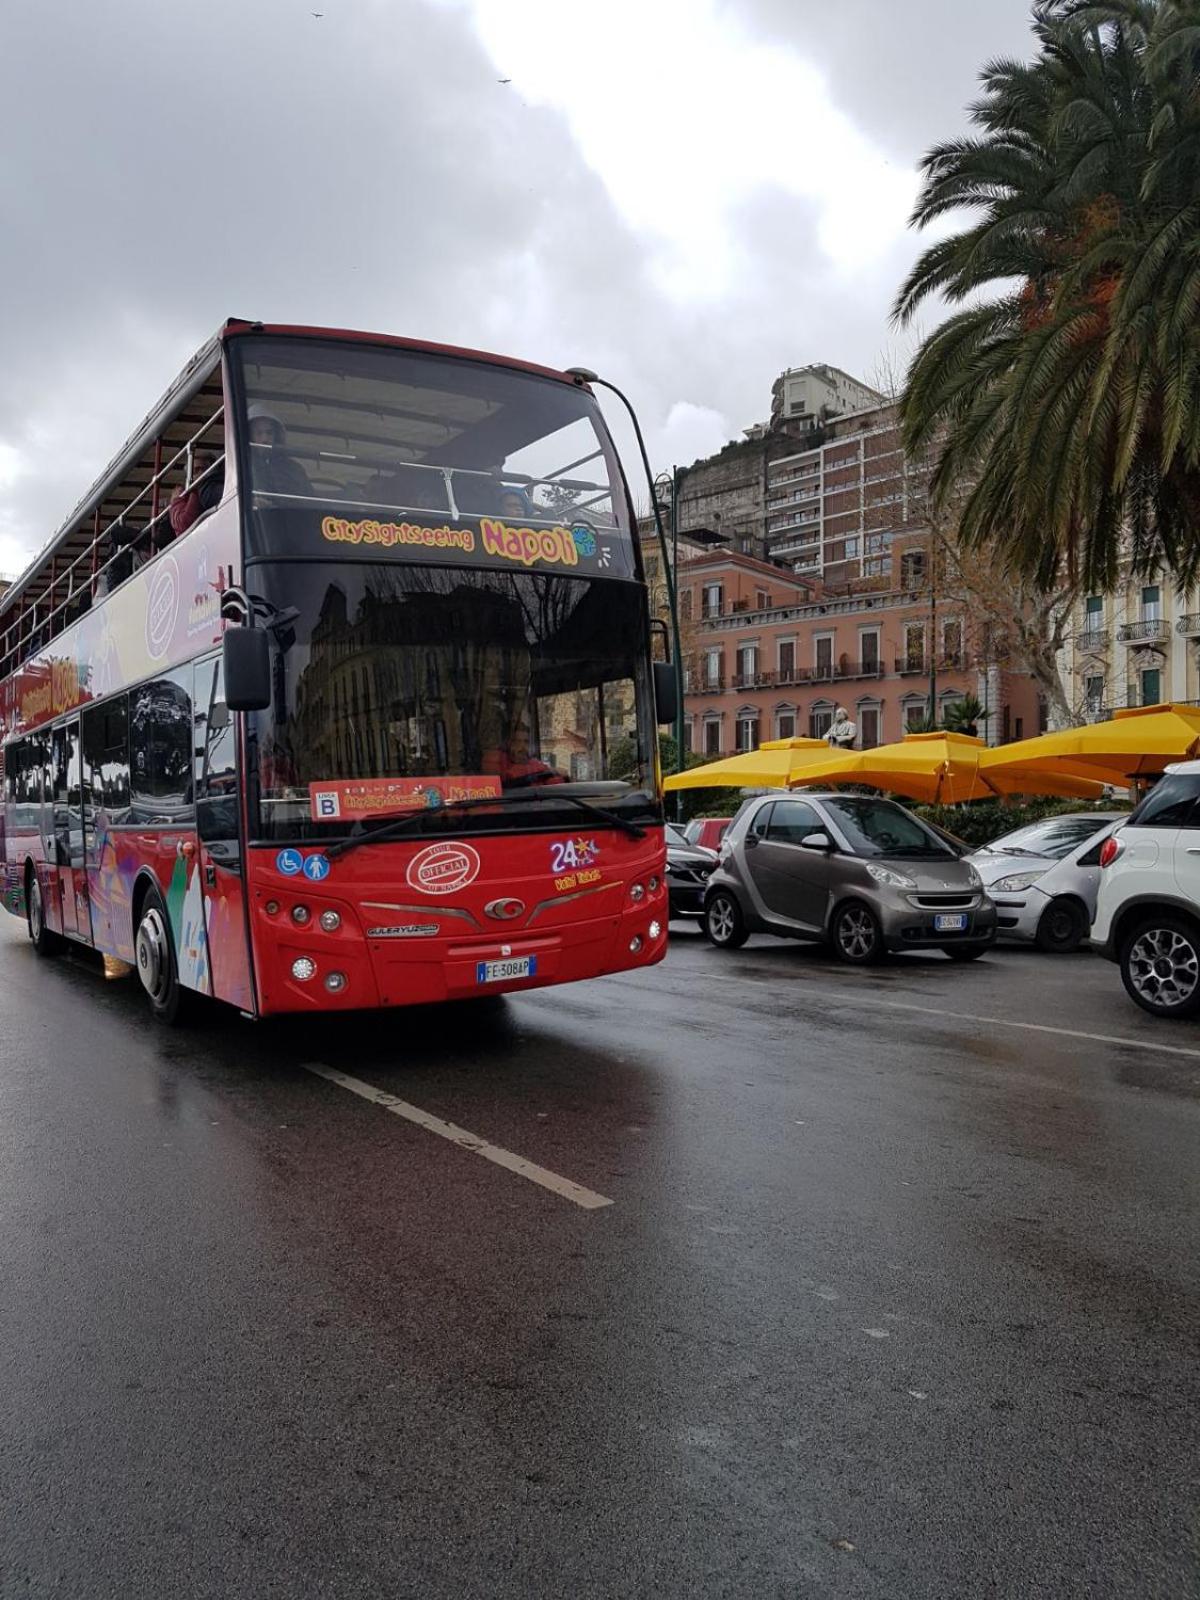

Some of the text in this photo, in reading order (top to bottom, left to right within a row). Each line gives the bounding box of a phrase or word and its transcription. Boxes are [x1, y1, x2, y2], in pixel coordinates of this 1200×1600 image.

[322, 515, 578, 566] CitySightseeing Napoli
[321, 799, 336, 816] B
[422, 859, 468, 879] OFFICIAL
[551, 840, 578, 872] 24
